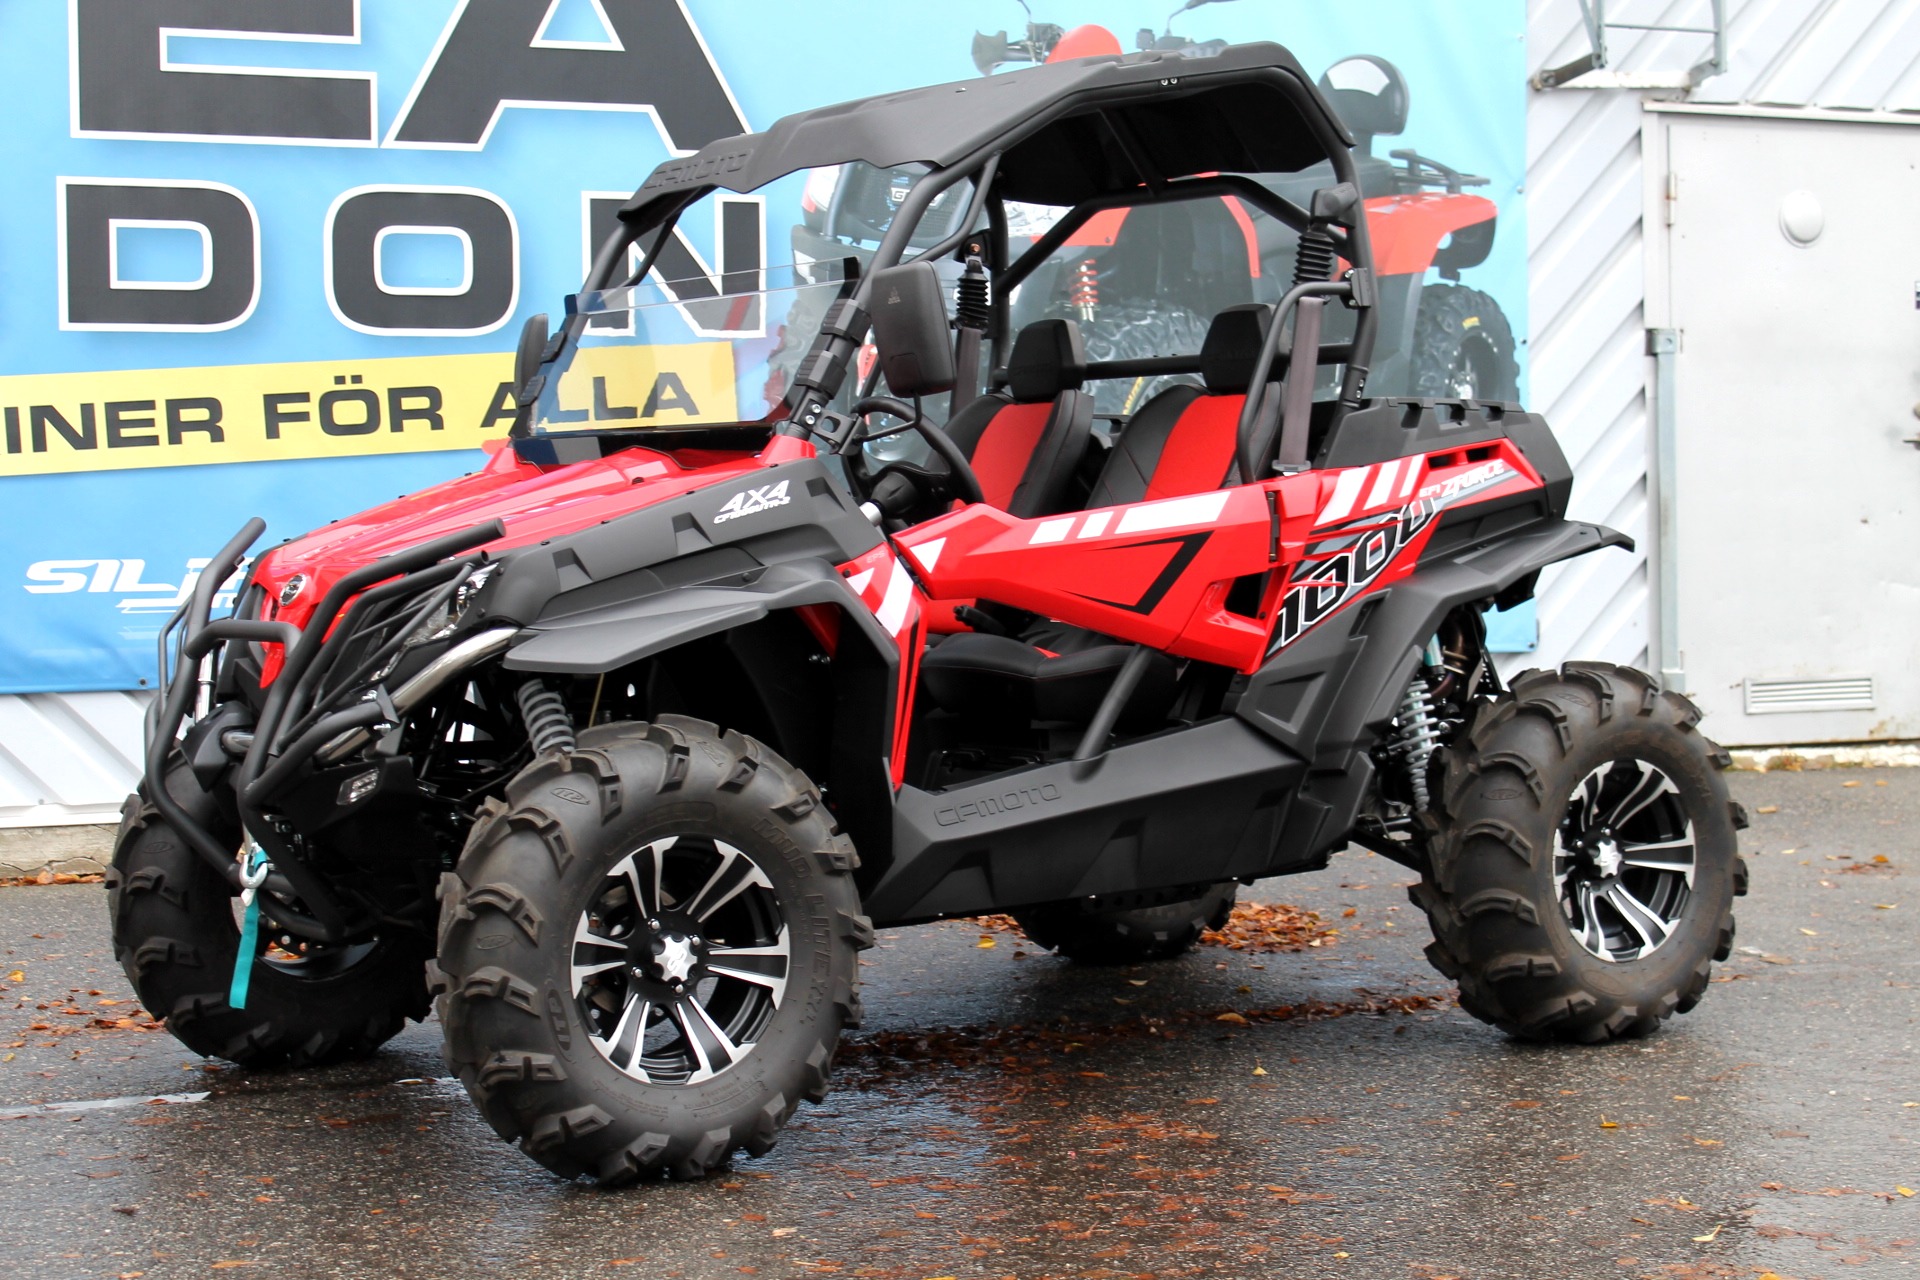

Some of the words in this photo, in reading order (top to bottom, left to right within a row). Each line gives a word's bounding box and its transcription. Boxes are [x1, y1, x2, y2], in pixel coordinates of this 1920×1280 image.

[56, 175, 768, 338] DON
[4, 397, 225, 454] INER
[263, 375, 444, 440] FÖR
[480, 372, 700, 428] ALLA
[719, 479, 790, 513] 4X4
[1419, 483, 1441, 498] EFI
[1441, 458, 1506, 498] ZFORCE
[933, 783, 1062, 827] CFMOTO
[752, 816, 814, 878] MUD
